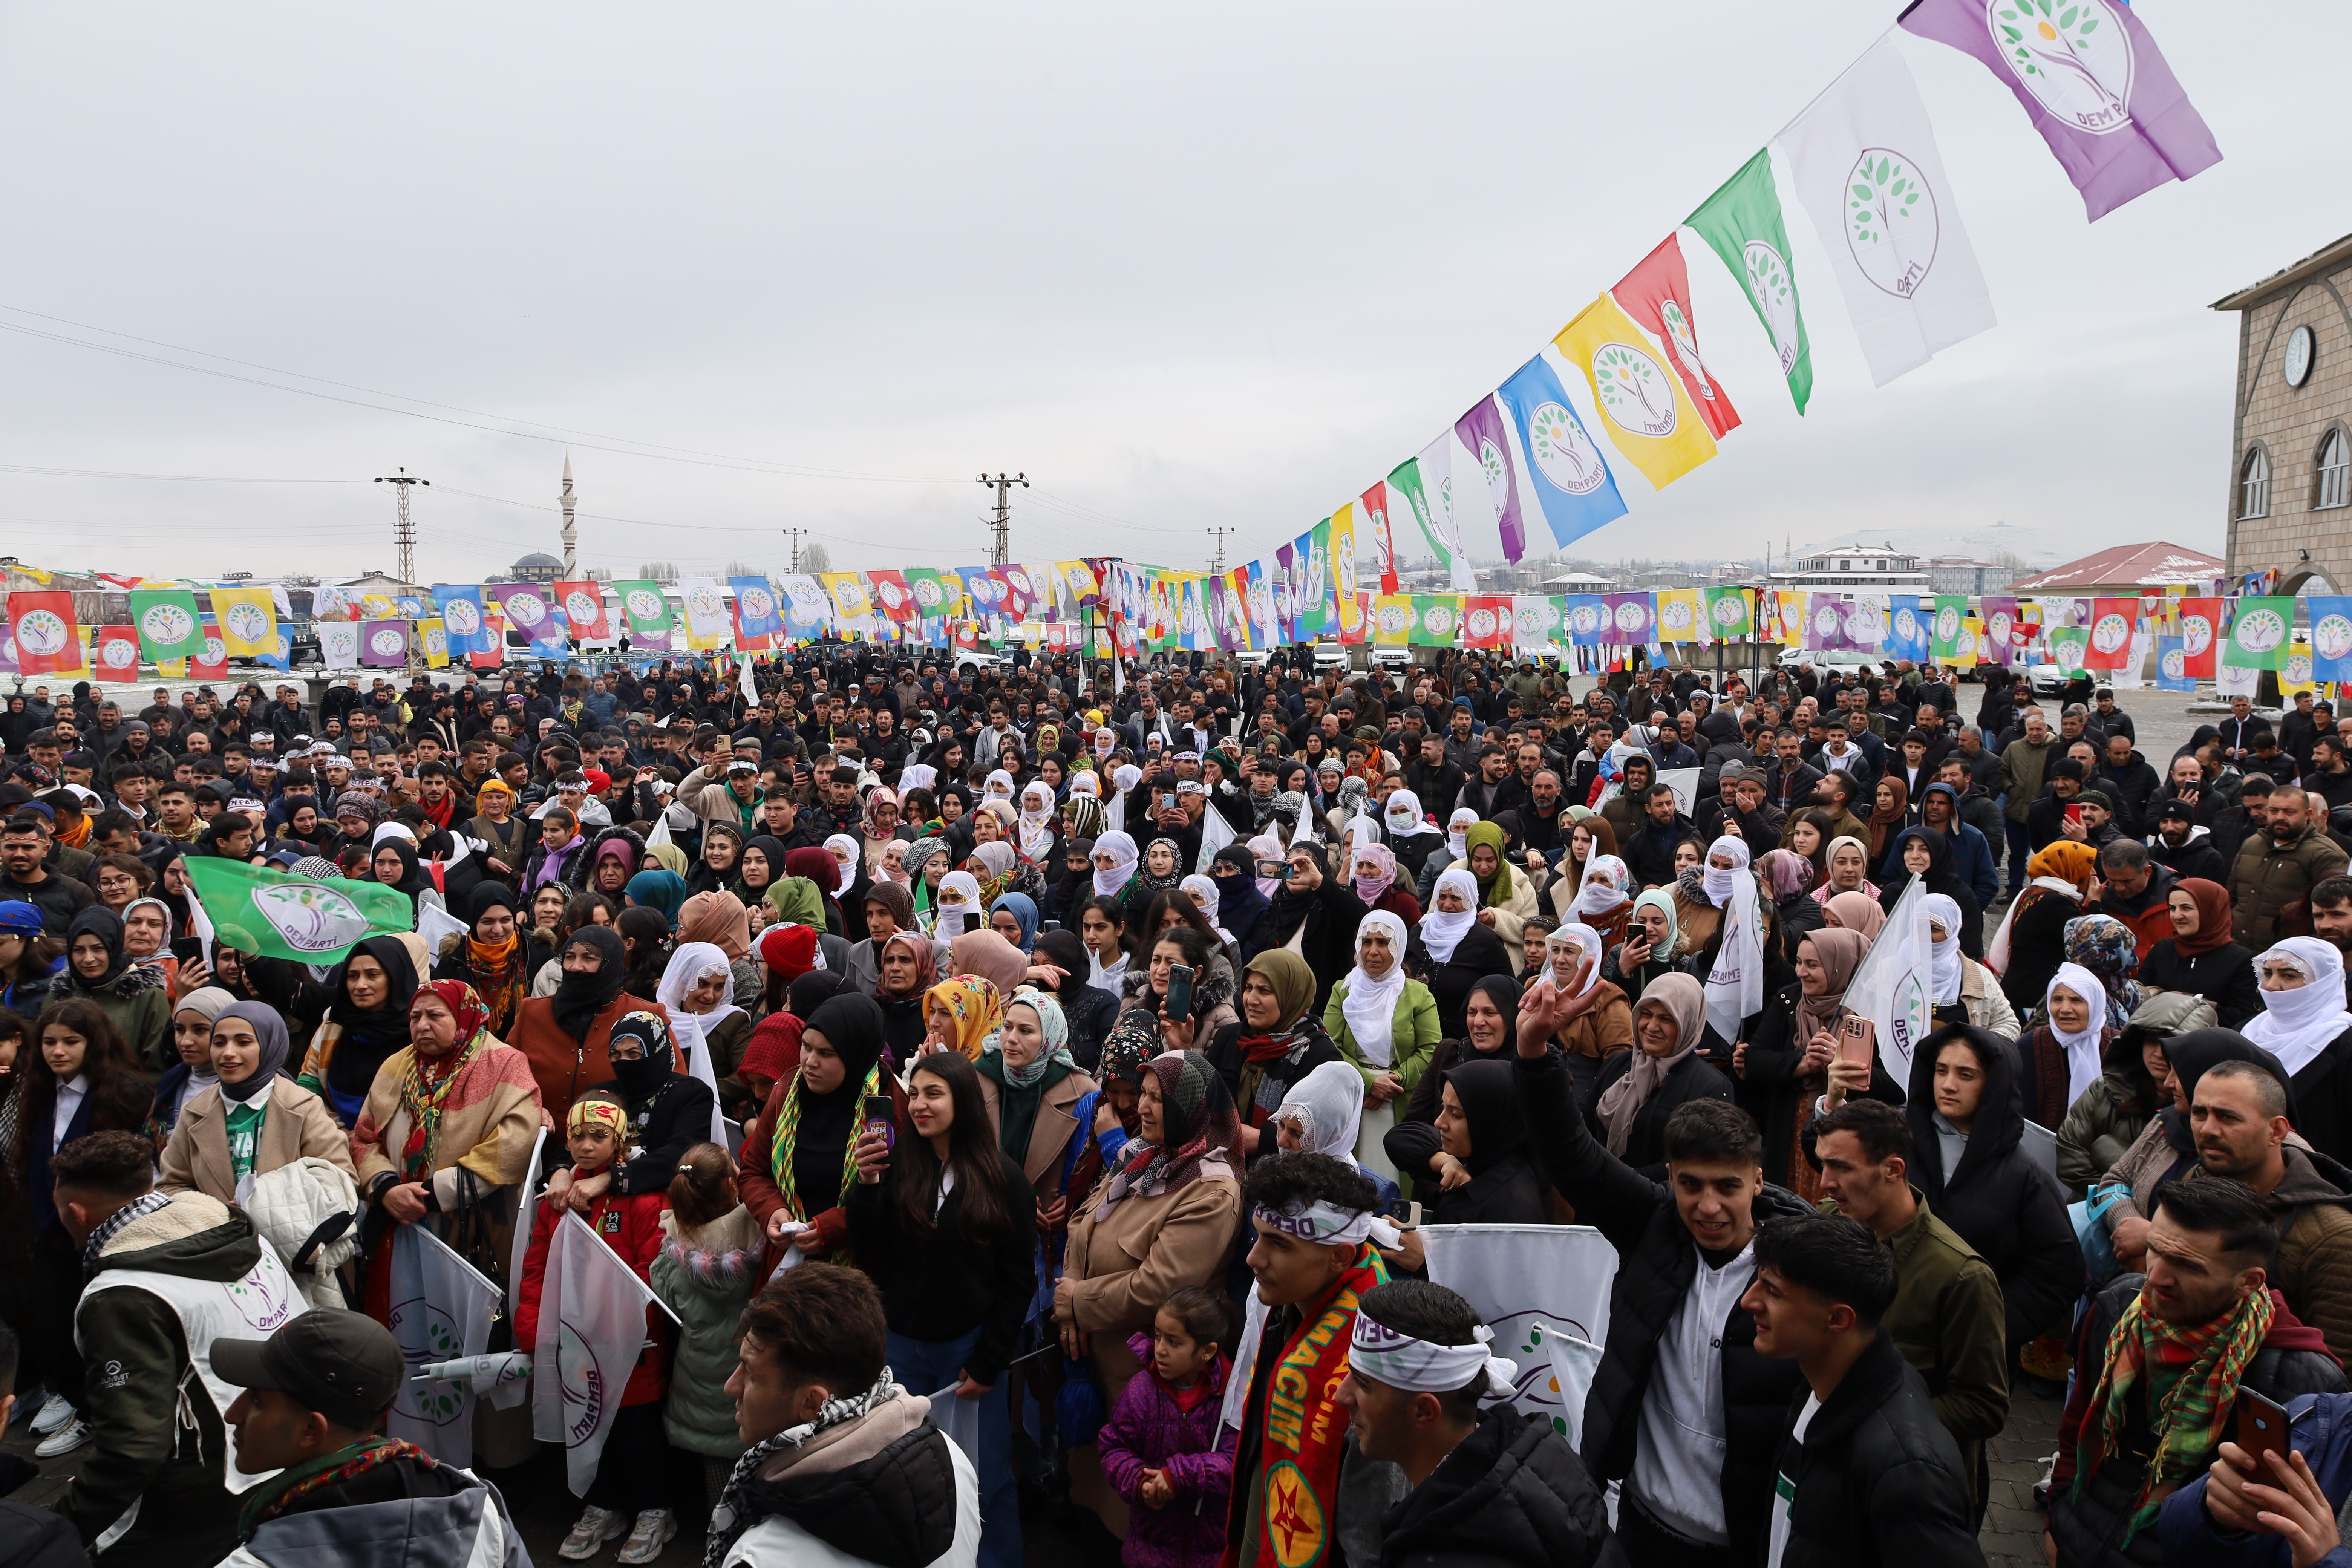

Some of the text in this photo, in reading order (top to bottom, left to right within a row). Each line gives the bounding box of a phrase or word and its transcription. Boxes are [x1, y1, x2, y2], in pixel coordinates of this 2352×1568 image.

[2076, 107, 2114, 127] DEM
[1568, 462, 1602, 490] DEM PARTİ
[528, 616, 541, 624] PARTİ
[169, 632, 185, 642] PARTİ
[1183, 782, 1201, 791] PARTİ
[285, 924, 337, 948] DEM PARTİ
[1894, 1020, 1909, 1048] DEM
[101, 1372, 130, 1384] SUMMIT
